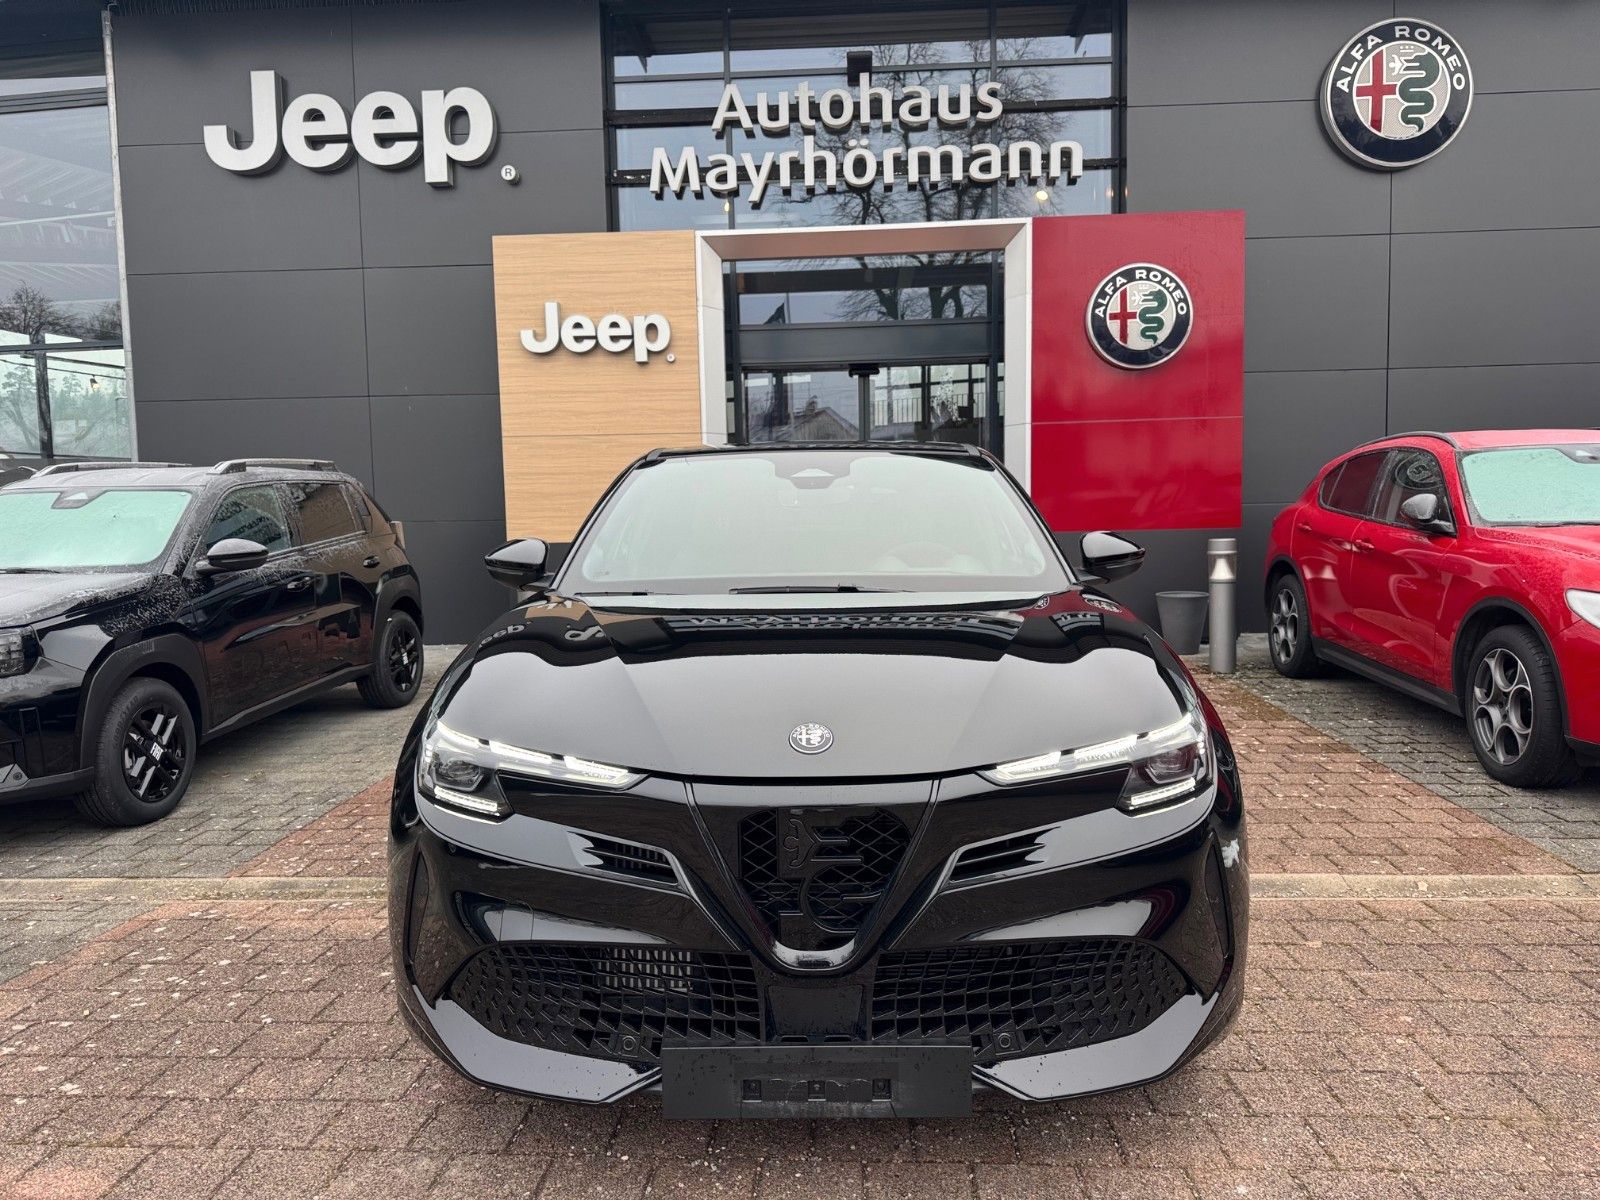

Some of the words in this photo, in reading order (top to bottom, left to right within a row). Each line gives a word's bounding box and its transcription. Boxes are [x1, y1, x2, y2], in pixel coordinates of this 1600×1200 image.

[1336, 34, 1383, 93] ALFA
[1394, 25, 1466, 91] ROMEO
[203, 70, 496, 185] Jeep
[711, 72, 1003, 134] Autohaus
[649, 135, 1083, 203] Mayrhörmann
[1094, 275, 1128, 318] ALFA
[1135, 269, 1187, 316] ROMEO
[520, 301, 671, 363] Jeep
